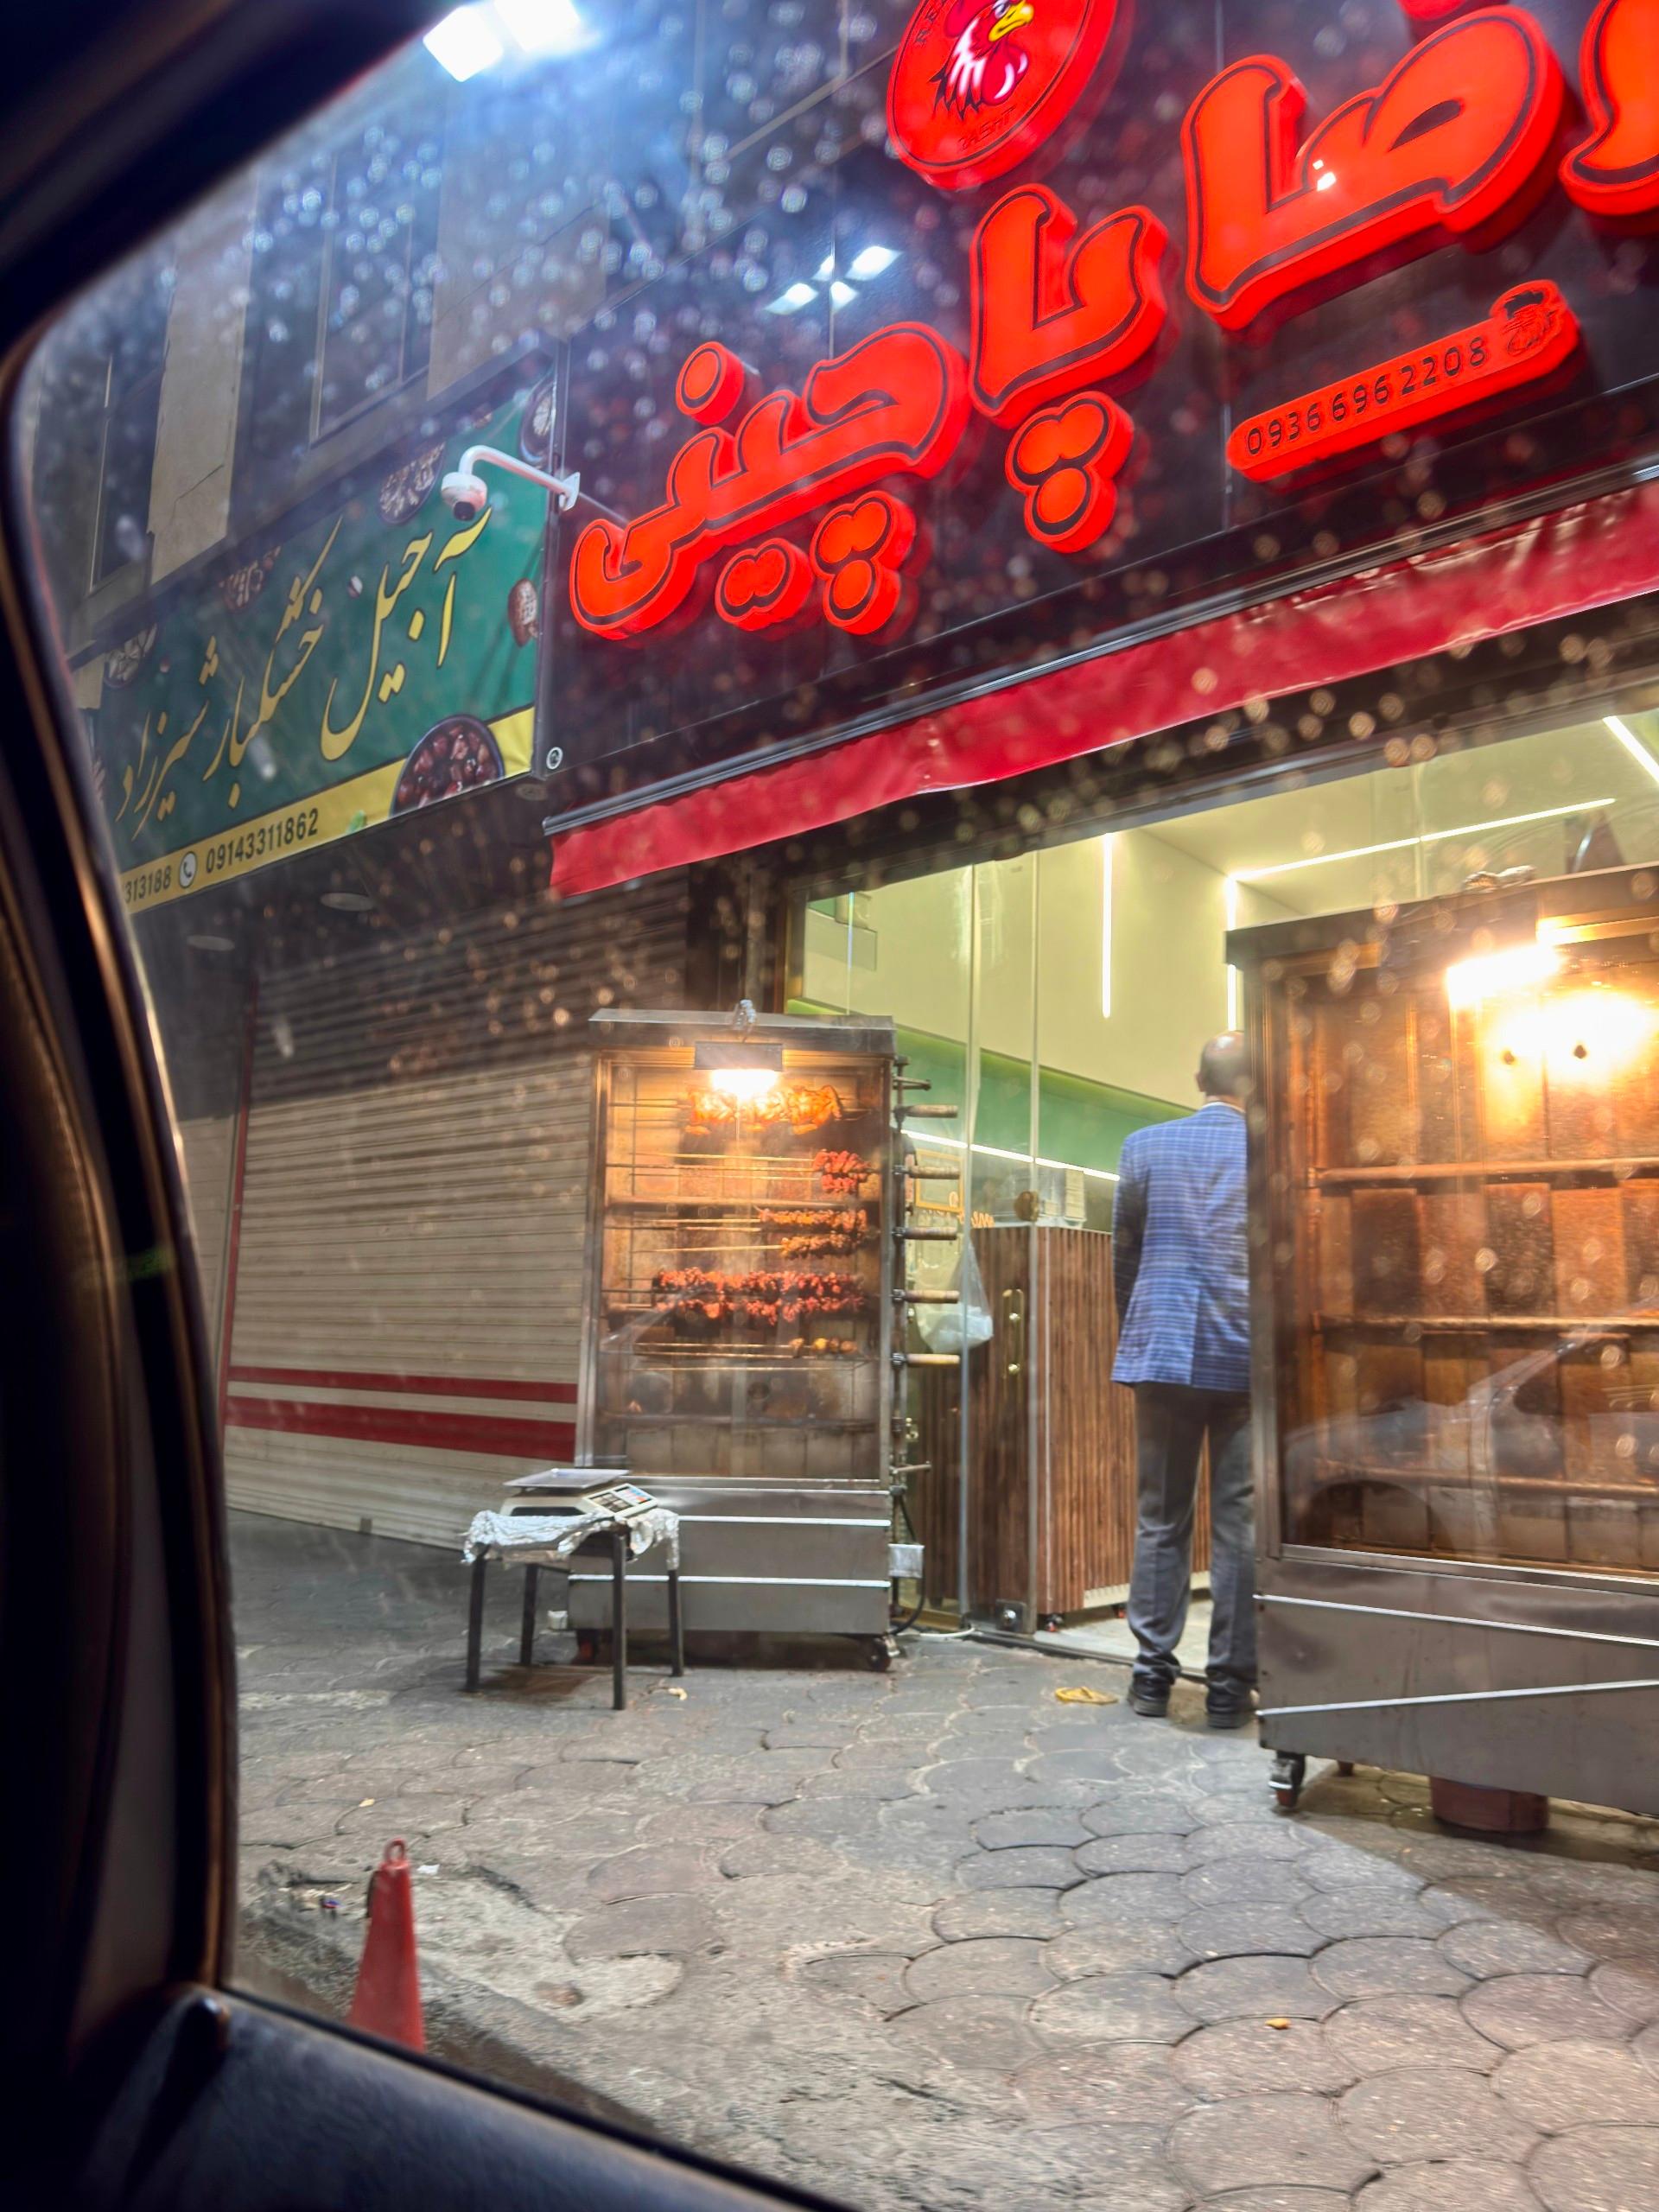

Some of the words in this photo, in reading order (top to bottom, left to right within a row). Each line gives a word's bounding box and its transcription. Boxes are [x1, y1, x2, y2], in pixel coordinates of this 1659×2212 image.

[203, 514, 343, 809] خشکبار
[320, 506, 493, 761] آجیل
[206, 808, 319, 874] 09143311862
